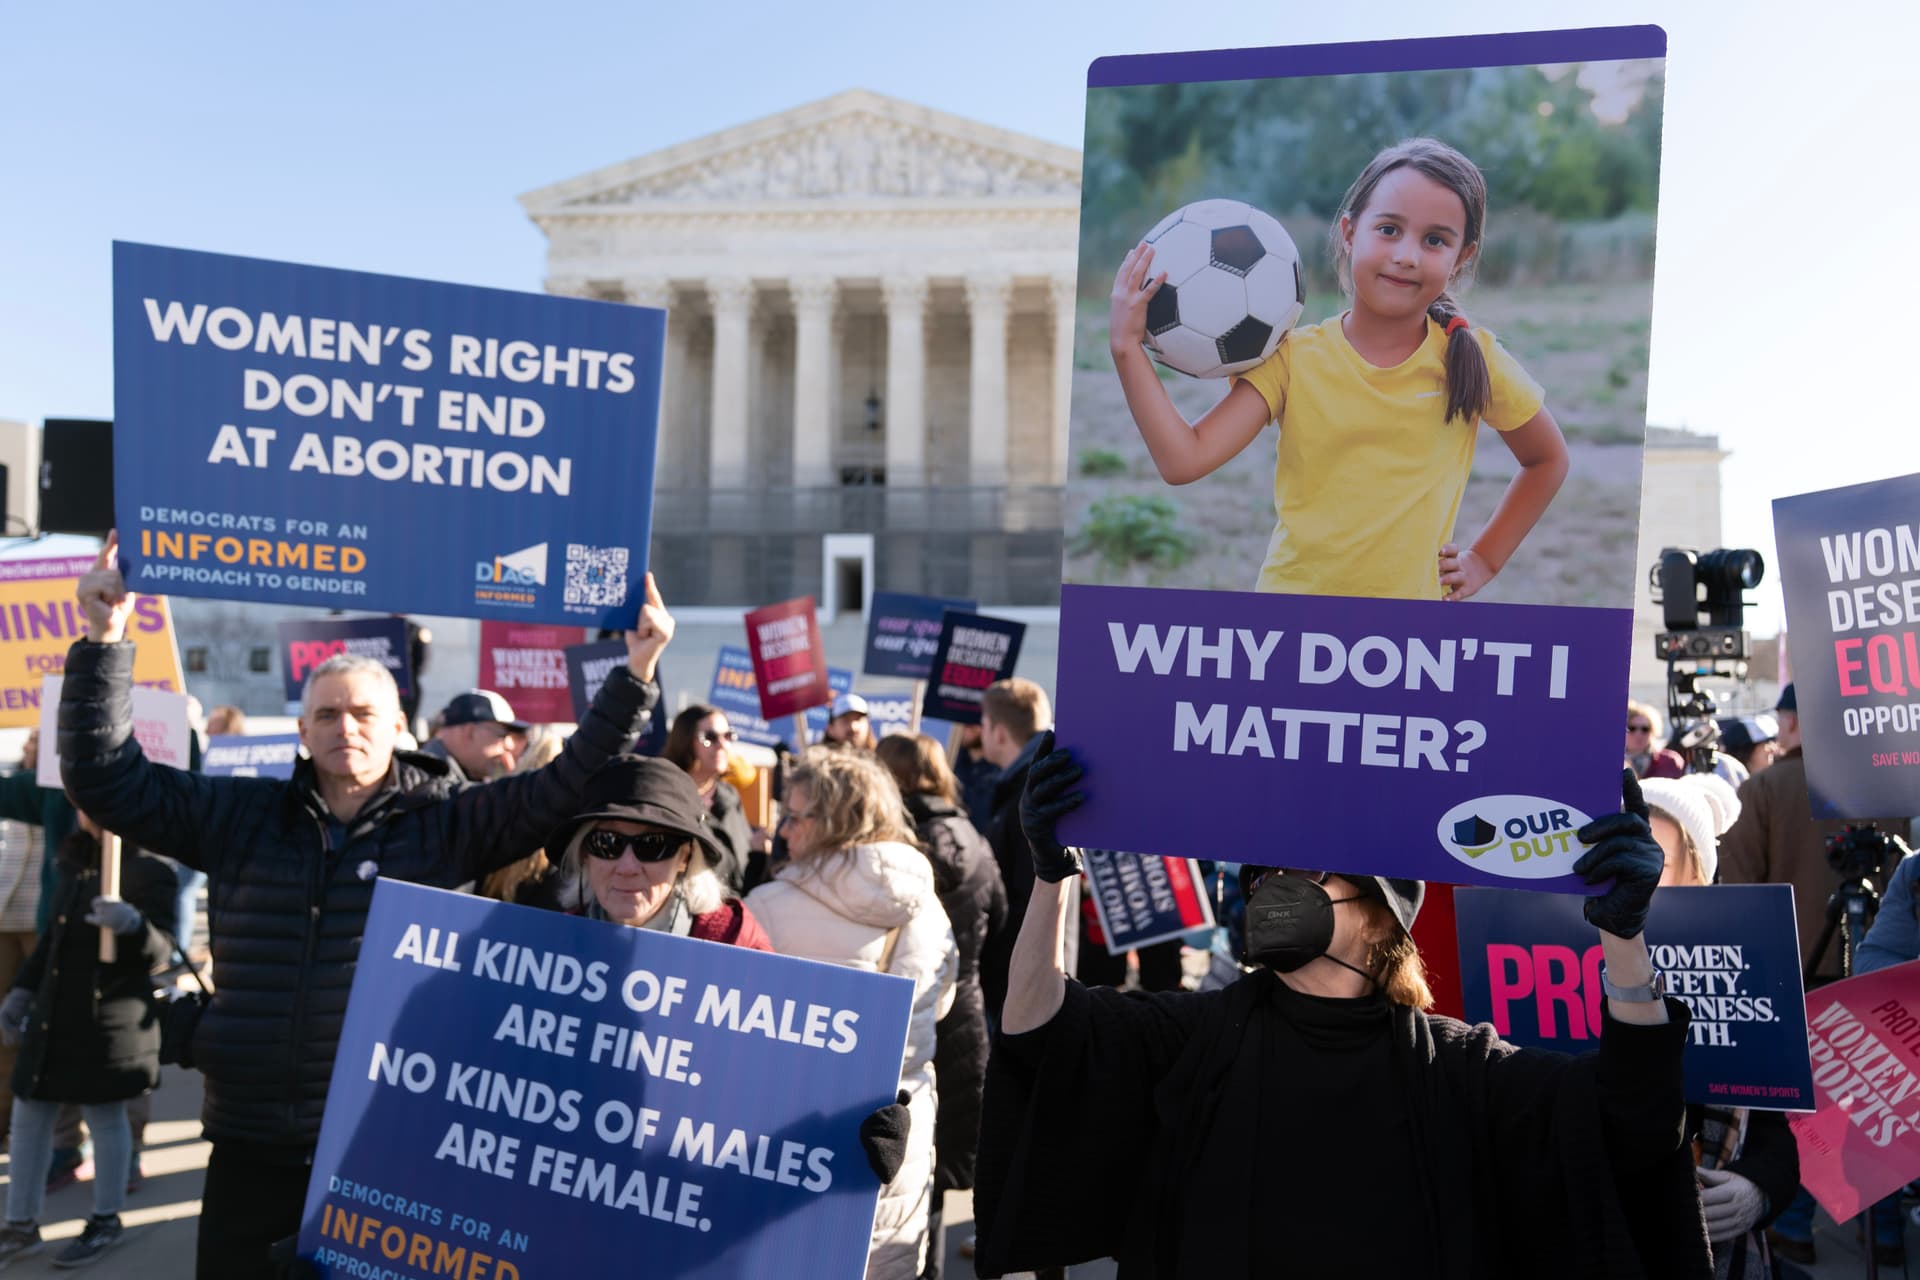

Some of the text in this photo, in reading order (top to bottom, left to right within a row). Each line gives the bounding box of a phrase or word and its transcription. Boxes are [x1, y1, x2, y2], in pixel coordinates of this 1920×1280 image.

[143, 298, 636, 393] WOMEN'S RIGHTS
[243, 369, 545, 438] DON'T END
[207, 425, 572, 496] AT ABORTION
[141, 506, 368, 539] DEMOCRATS FOR AN
[141, 530, 366, 574] INFORMED
[141, 564, 366, 596] APPROACH TO GENDER
[1107, 622, 1569, 699] WHY DON'T I
[1173, 702, 1488, 773] MATTER?
[1872, 752, 1900, 767] SAVE
[1504, 808, 1573, 840] OUR
[392, 923, 860, 1054] ALL KINDS OF MALES
[1663, 970, 1748, 996] FETY.
[493, 1002, 702, 1087] ARE FINE.
[367, 1042, 835, 1193] NO KINDS OF MALES
[1708, 1083, 1801, 1099] SAVE WOMEN'S SPORTS
[434, 1122, 712, 1233] ARE FEMALE.
[319, 1203, 520, 1280] INFORMED
[328, 1175, 529, 1253] DEMOCRATS FOR AN
